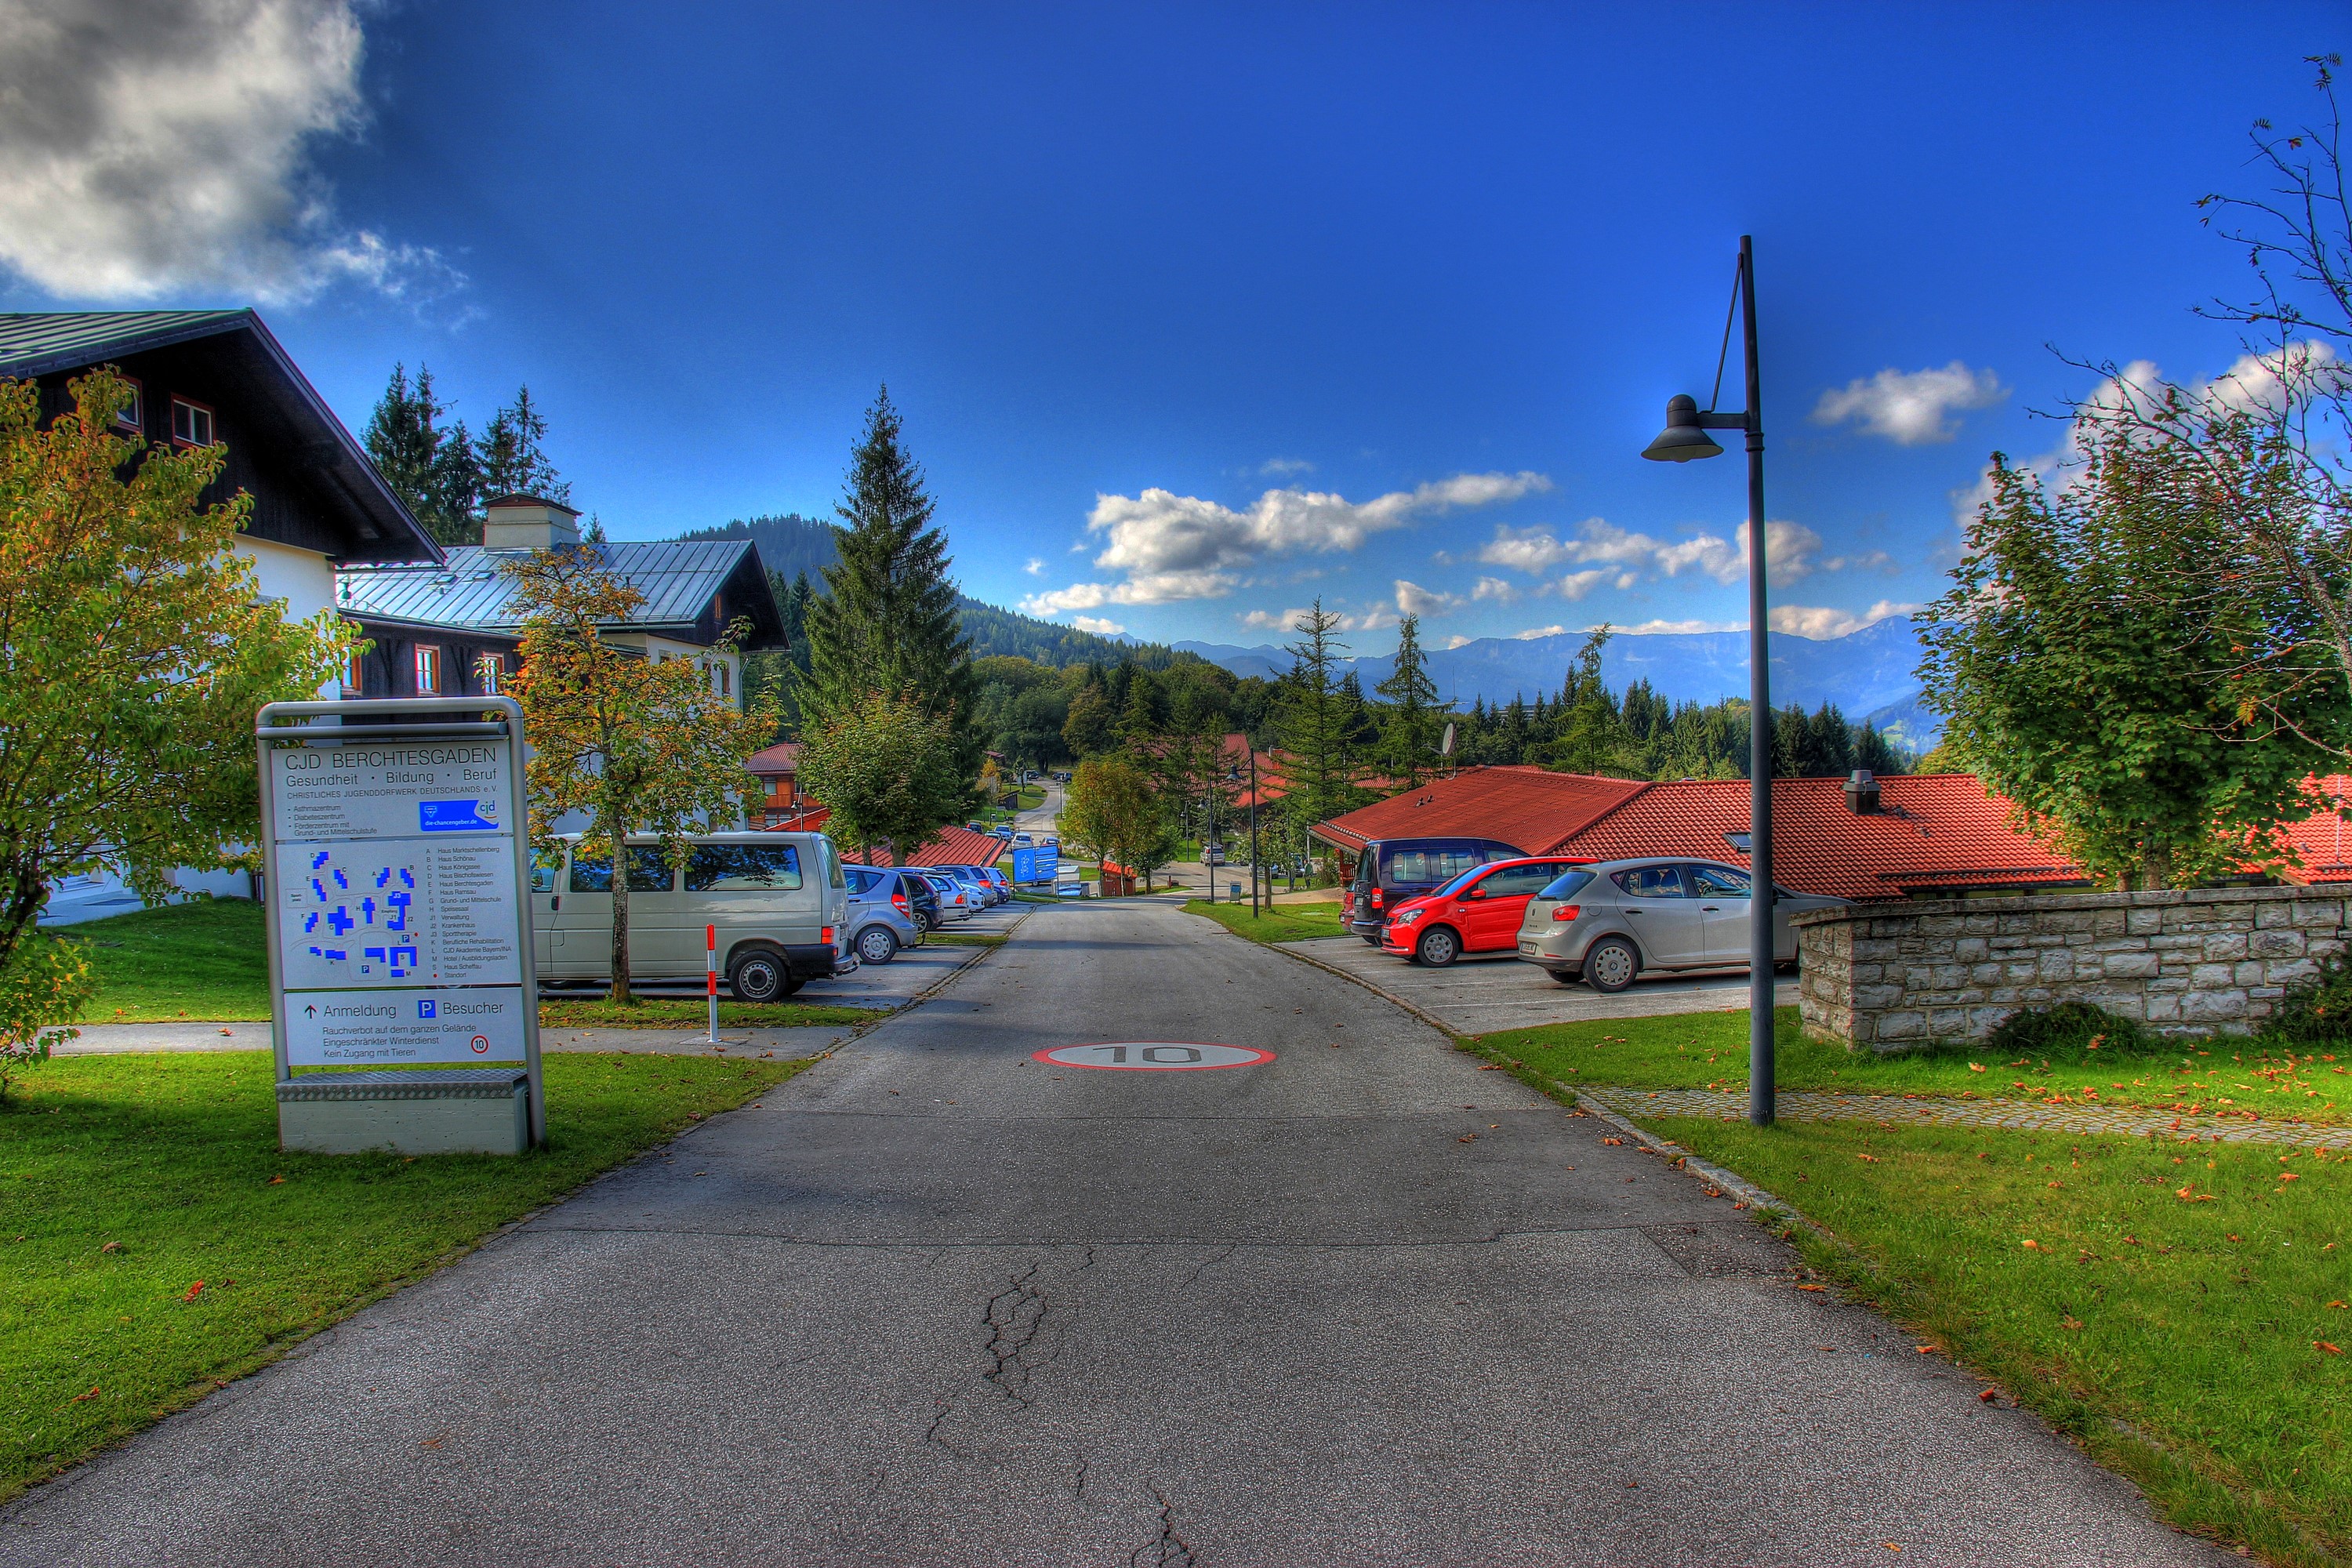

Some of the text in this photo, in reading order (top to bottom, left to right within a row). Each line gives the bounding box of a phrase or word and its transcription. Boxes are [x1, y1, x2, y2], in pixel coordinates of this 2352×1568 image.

[286, 748, 496, 770] CJD BERCHTESGADEN
[287, 768, 497, 787] Gesundheit Bildung Beruf
[344, 788, 417, 798] JUGENDDORFWERK
[420, 786, 481, 795] DEUTSCHLANDS
[480, 800, 495, 814] cjd
[324, 1005, 397, 1019] Anmeldung
[421, 1002, 432, 1016] P
[443, 1002, 503, 1015] Besucher
[323, 1026, 373, 1035] Rauchverbot
[390, 1025, 408, 1034] dem
[411, 1025, 440, 1035] ganzen
[443, 1024, 476, 1032] Gelände
[323, 1036, 439, 1048] Eingeschränkter Winterdienst
[475, 1040, 484, 1049] 10
[344, 1049, 374, 1059] Zugang
[392, 1048, 416, 1056] Tieren
[1093, 1047, 1202, 1062] 10
